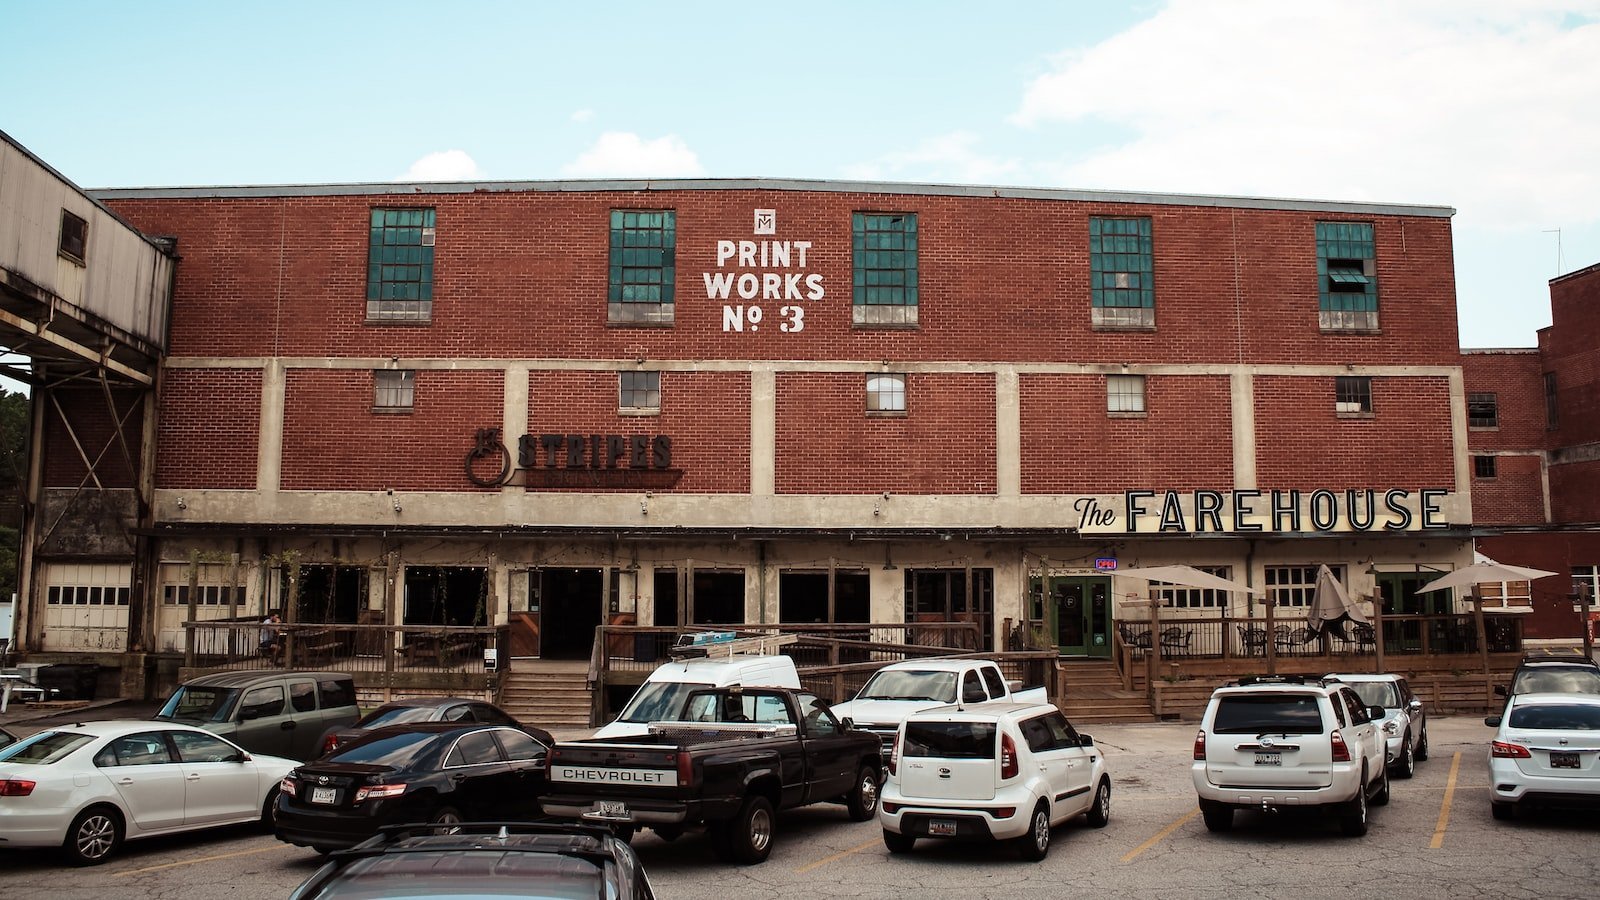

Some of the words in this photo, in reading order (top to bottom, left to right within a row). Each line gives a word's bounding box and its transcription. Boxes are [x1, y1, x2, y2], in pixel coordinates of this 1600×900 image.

[717, 240, 812, 268] PRINT
[702, 272, 825, 300] WORKS
[780, 305, 805, 332] 3
[518, 434, 672, 468] STRIPES
[1073, 497, 1116, 529] The
[1124, 488, 1450, 532] FAREHOUSE
[563, 769, 664, 783] CHEVROLET
